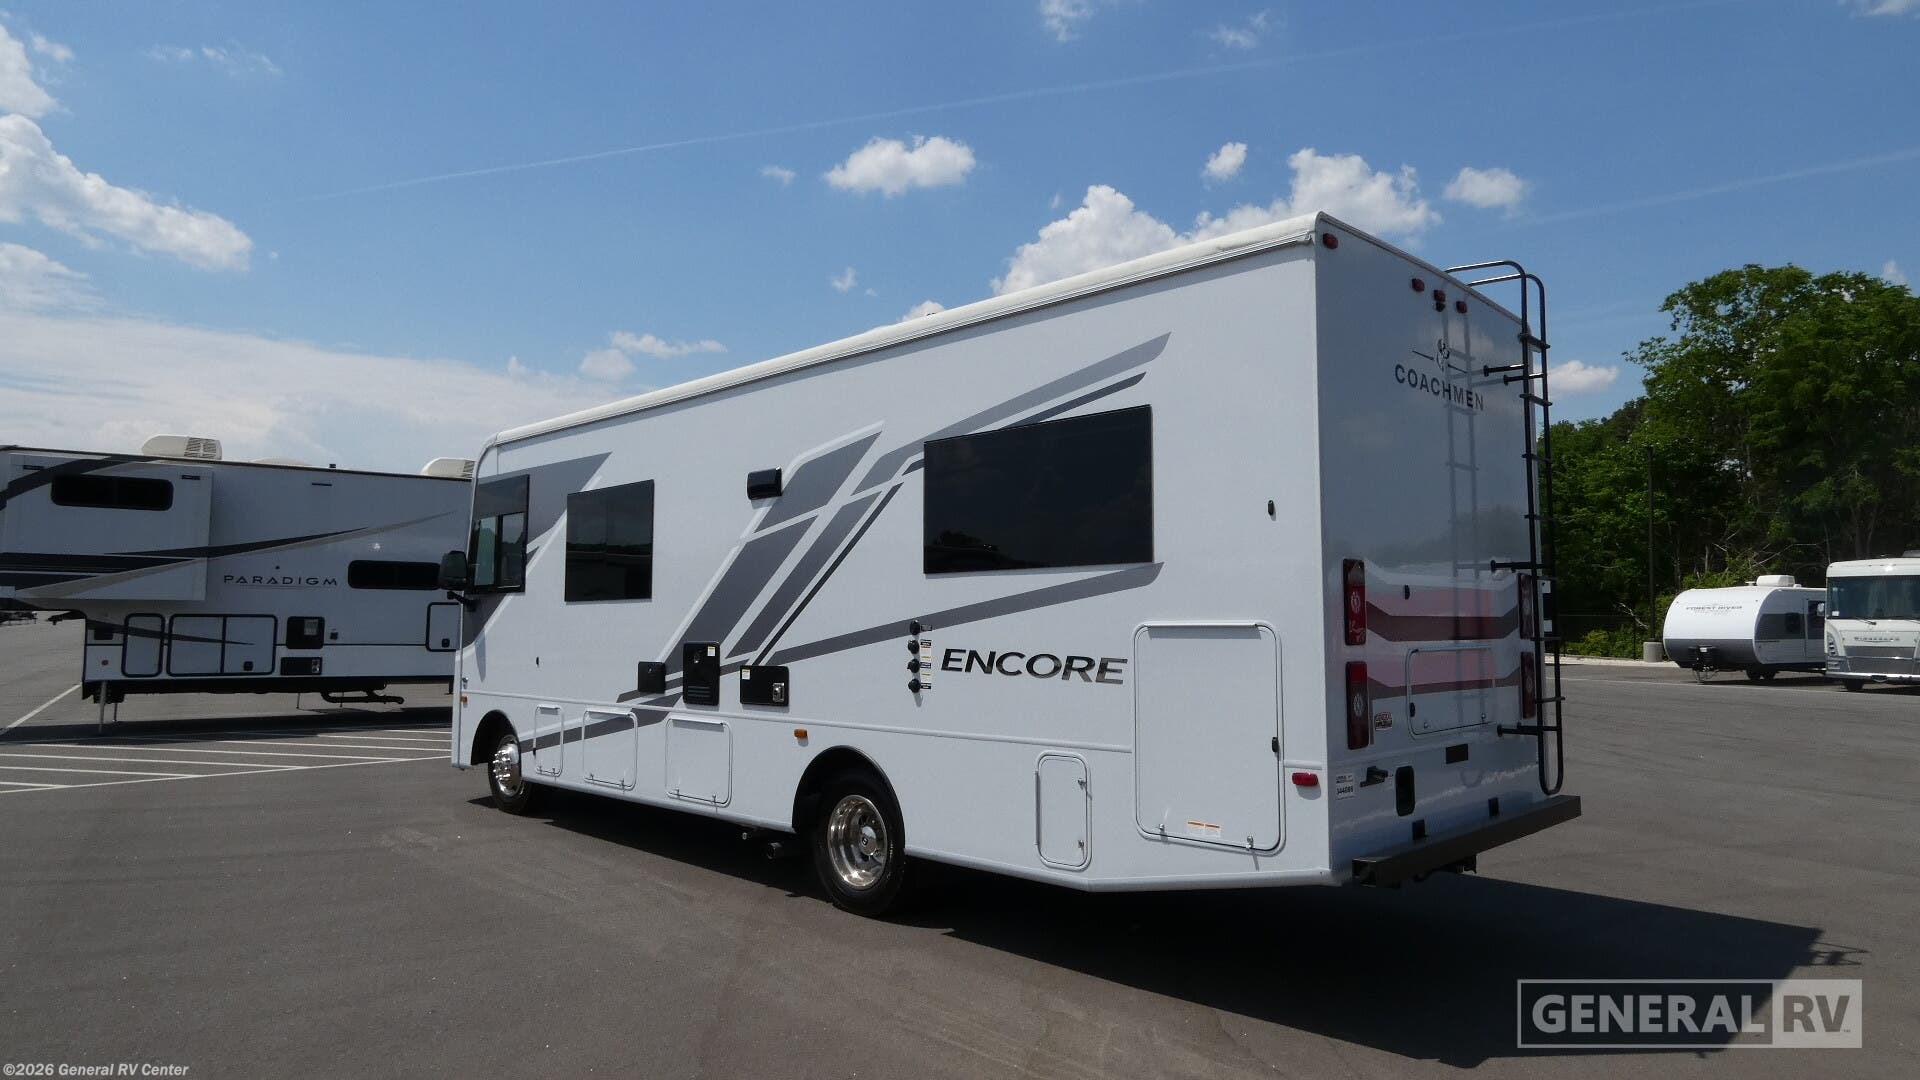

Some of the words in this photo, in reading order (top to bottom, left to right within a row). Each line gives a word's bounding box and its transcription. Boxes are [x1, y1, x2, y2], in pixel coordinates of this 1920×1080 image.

[1395, 364, 1484, 411] COACHMEN
[223, 575, 338, 586] PARADIGM
[941, 648, 1128, 685] ENCORE
